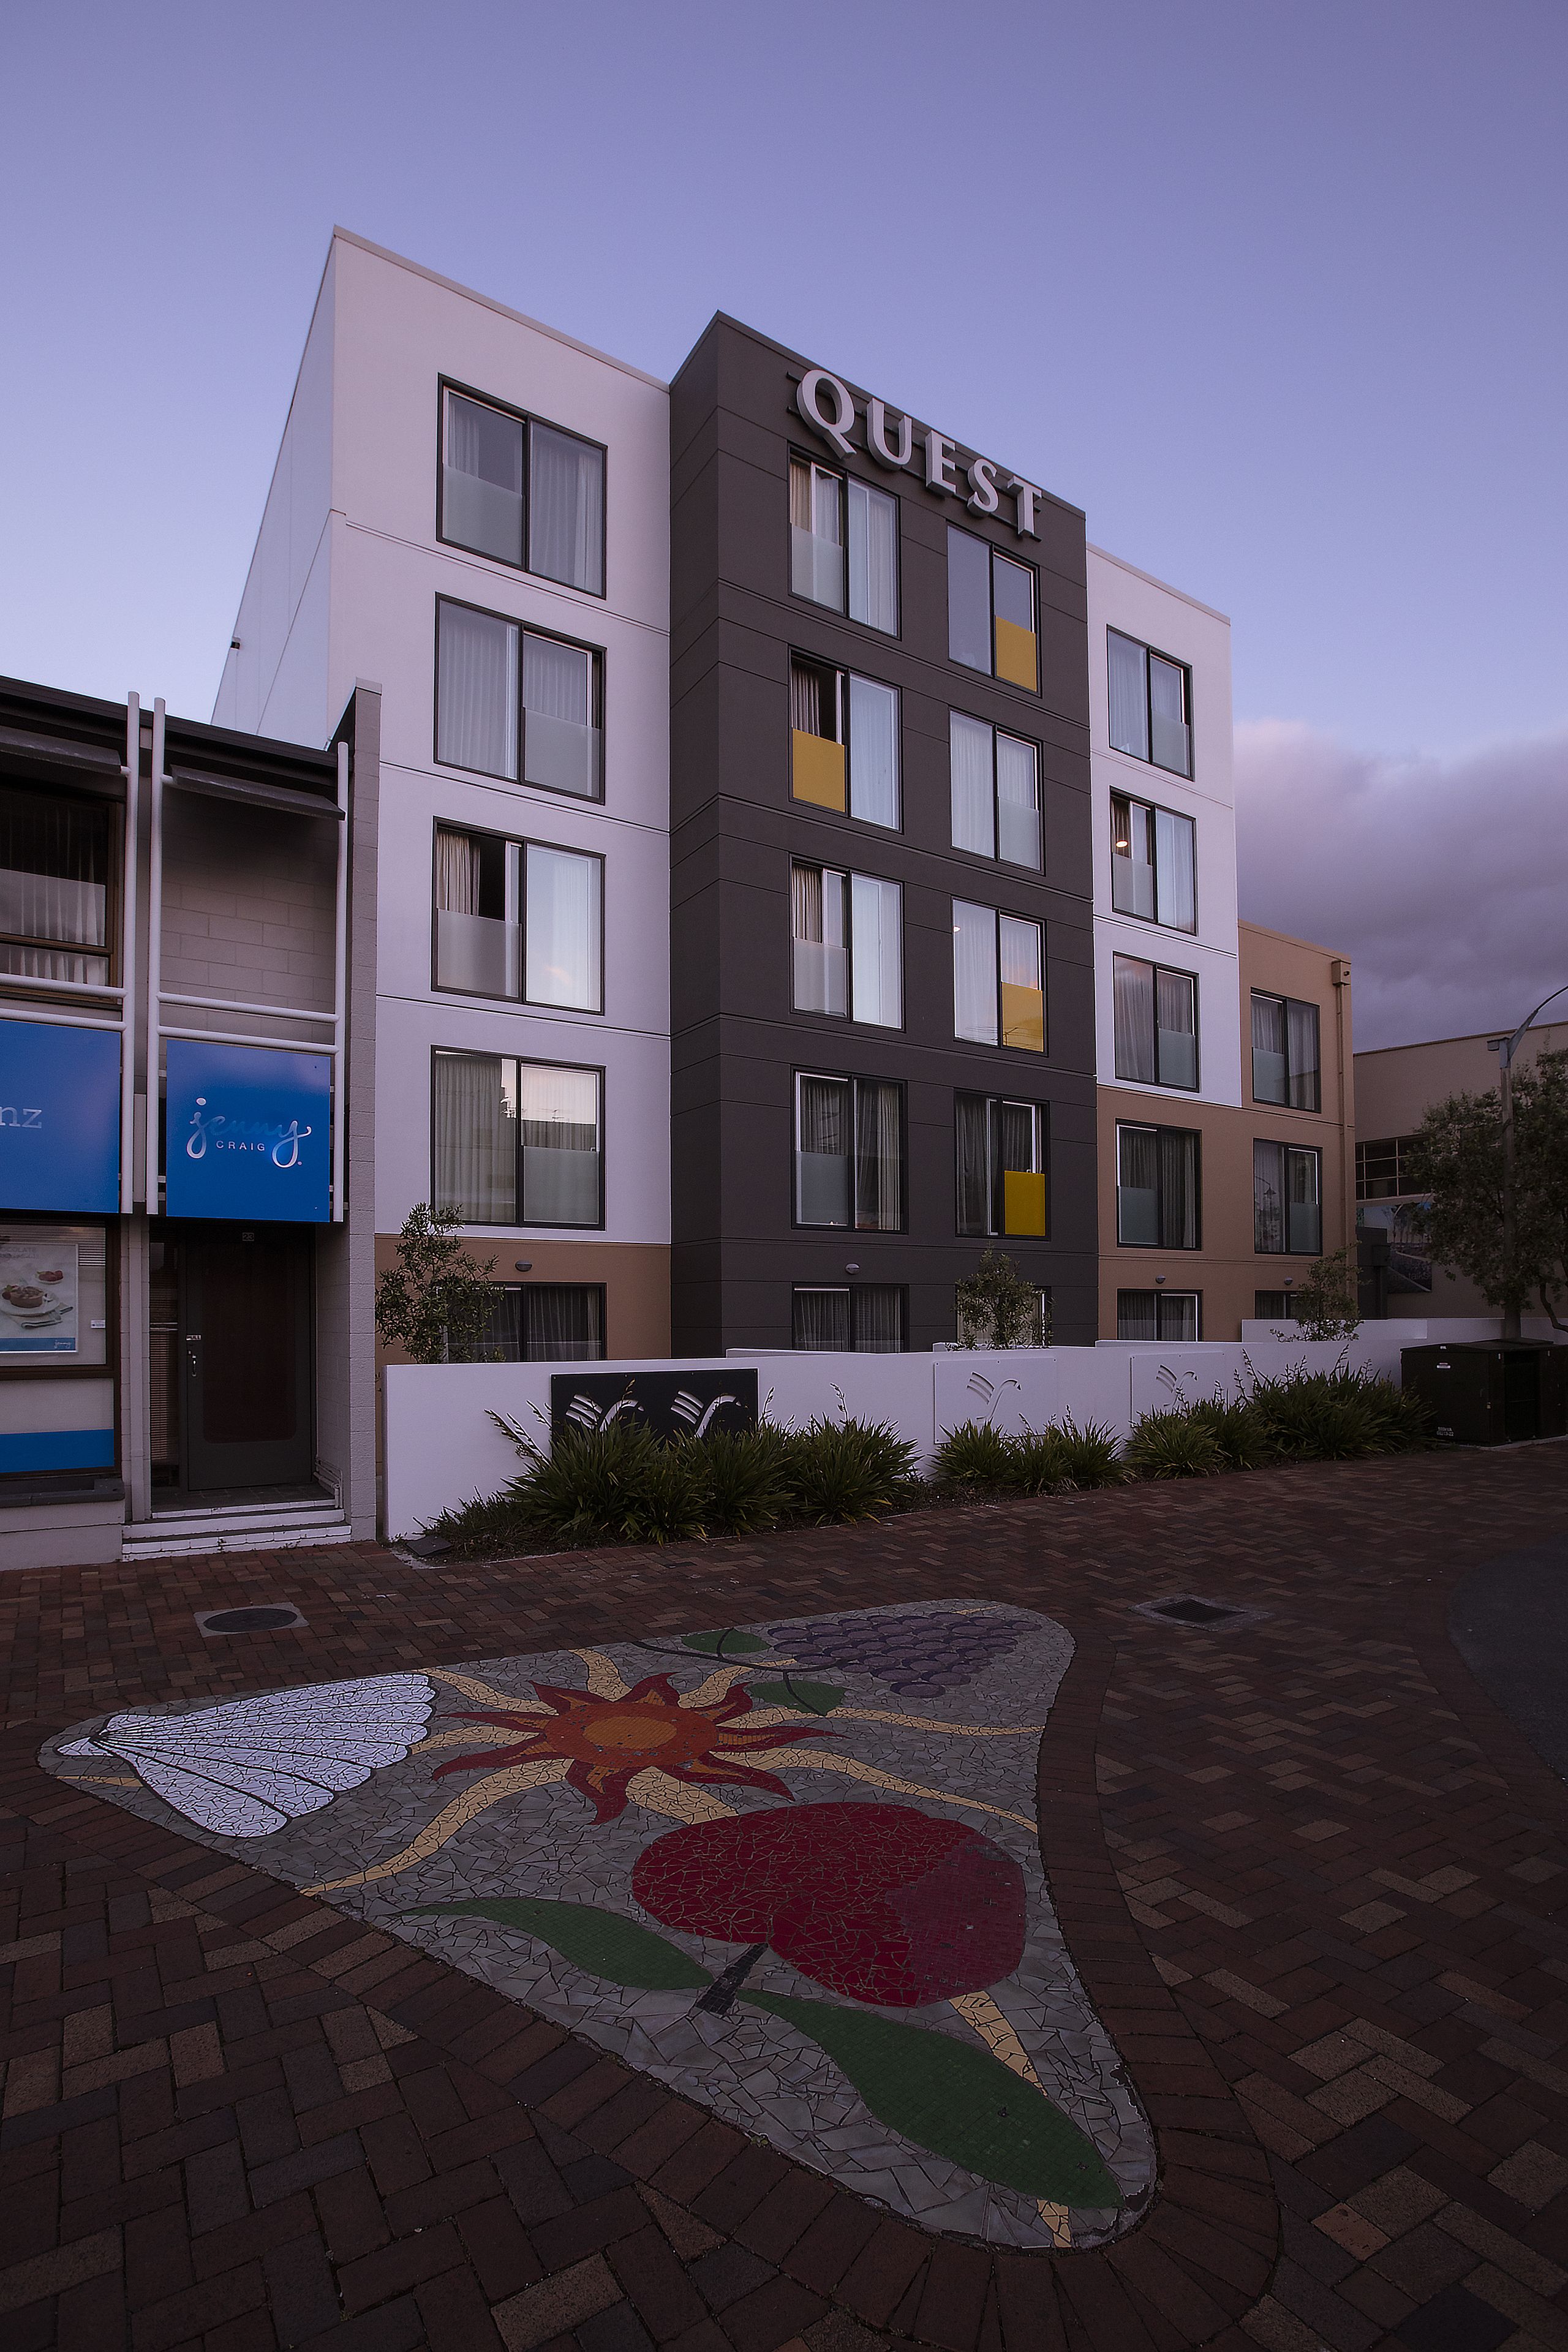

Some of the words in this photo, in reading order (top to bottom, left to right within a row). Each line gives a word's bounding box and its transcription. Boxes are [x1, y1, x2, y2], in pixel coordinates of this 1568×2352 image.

[796, 369, 1042, 535] QUEST
[0, 1106, 42, 1129] nz
[216, 1140, 265, 1152] CRAIG
